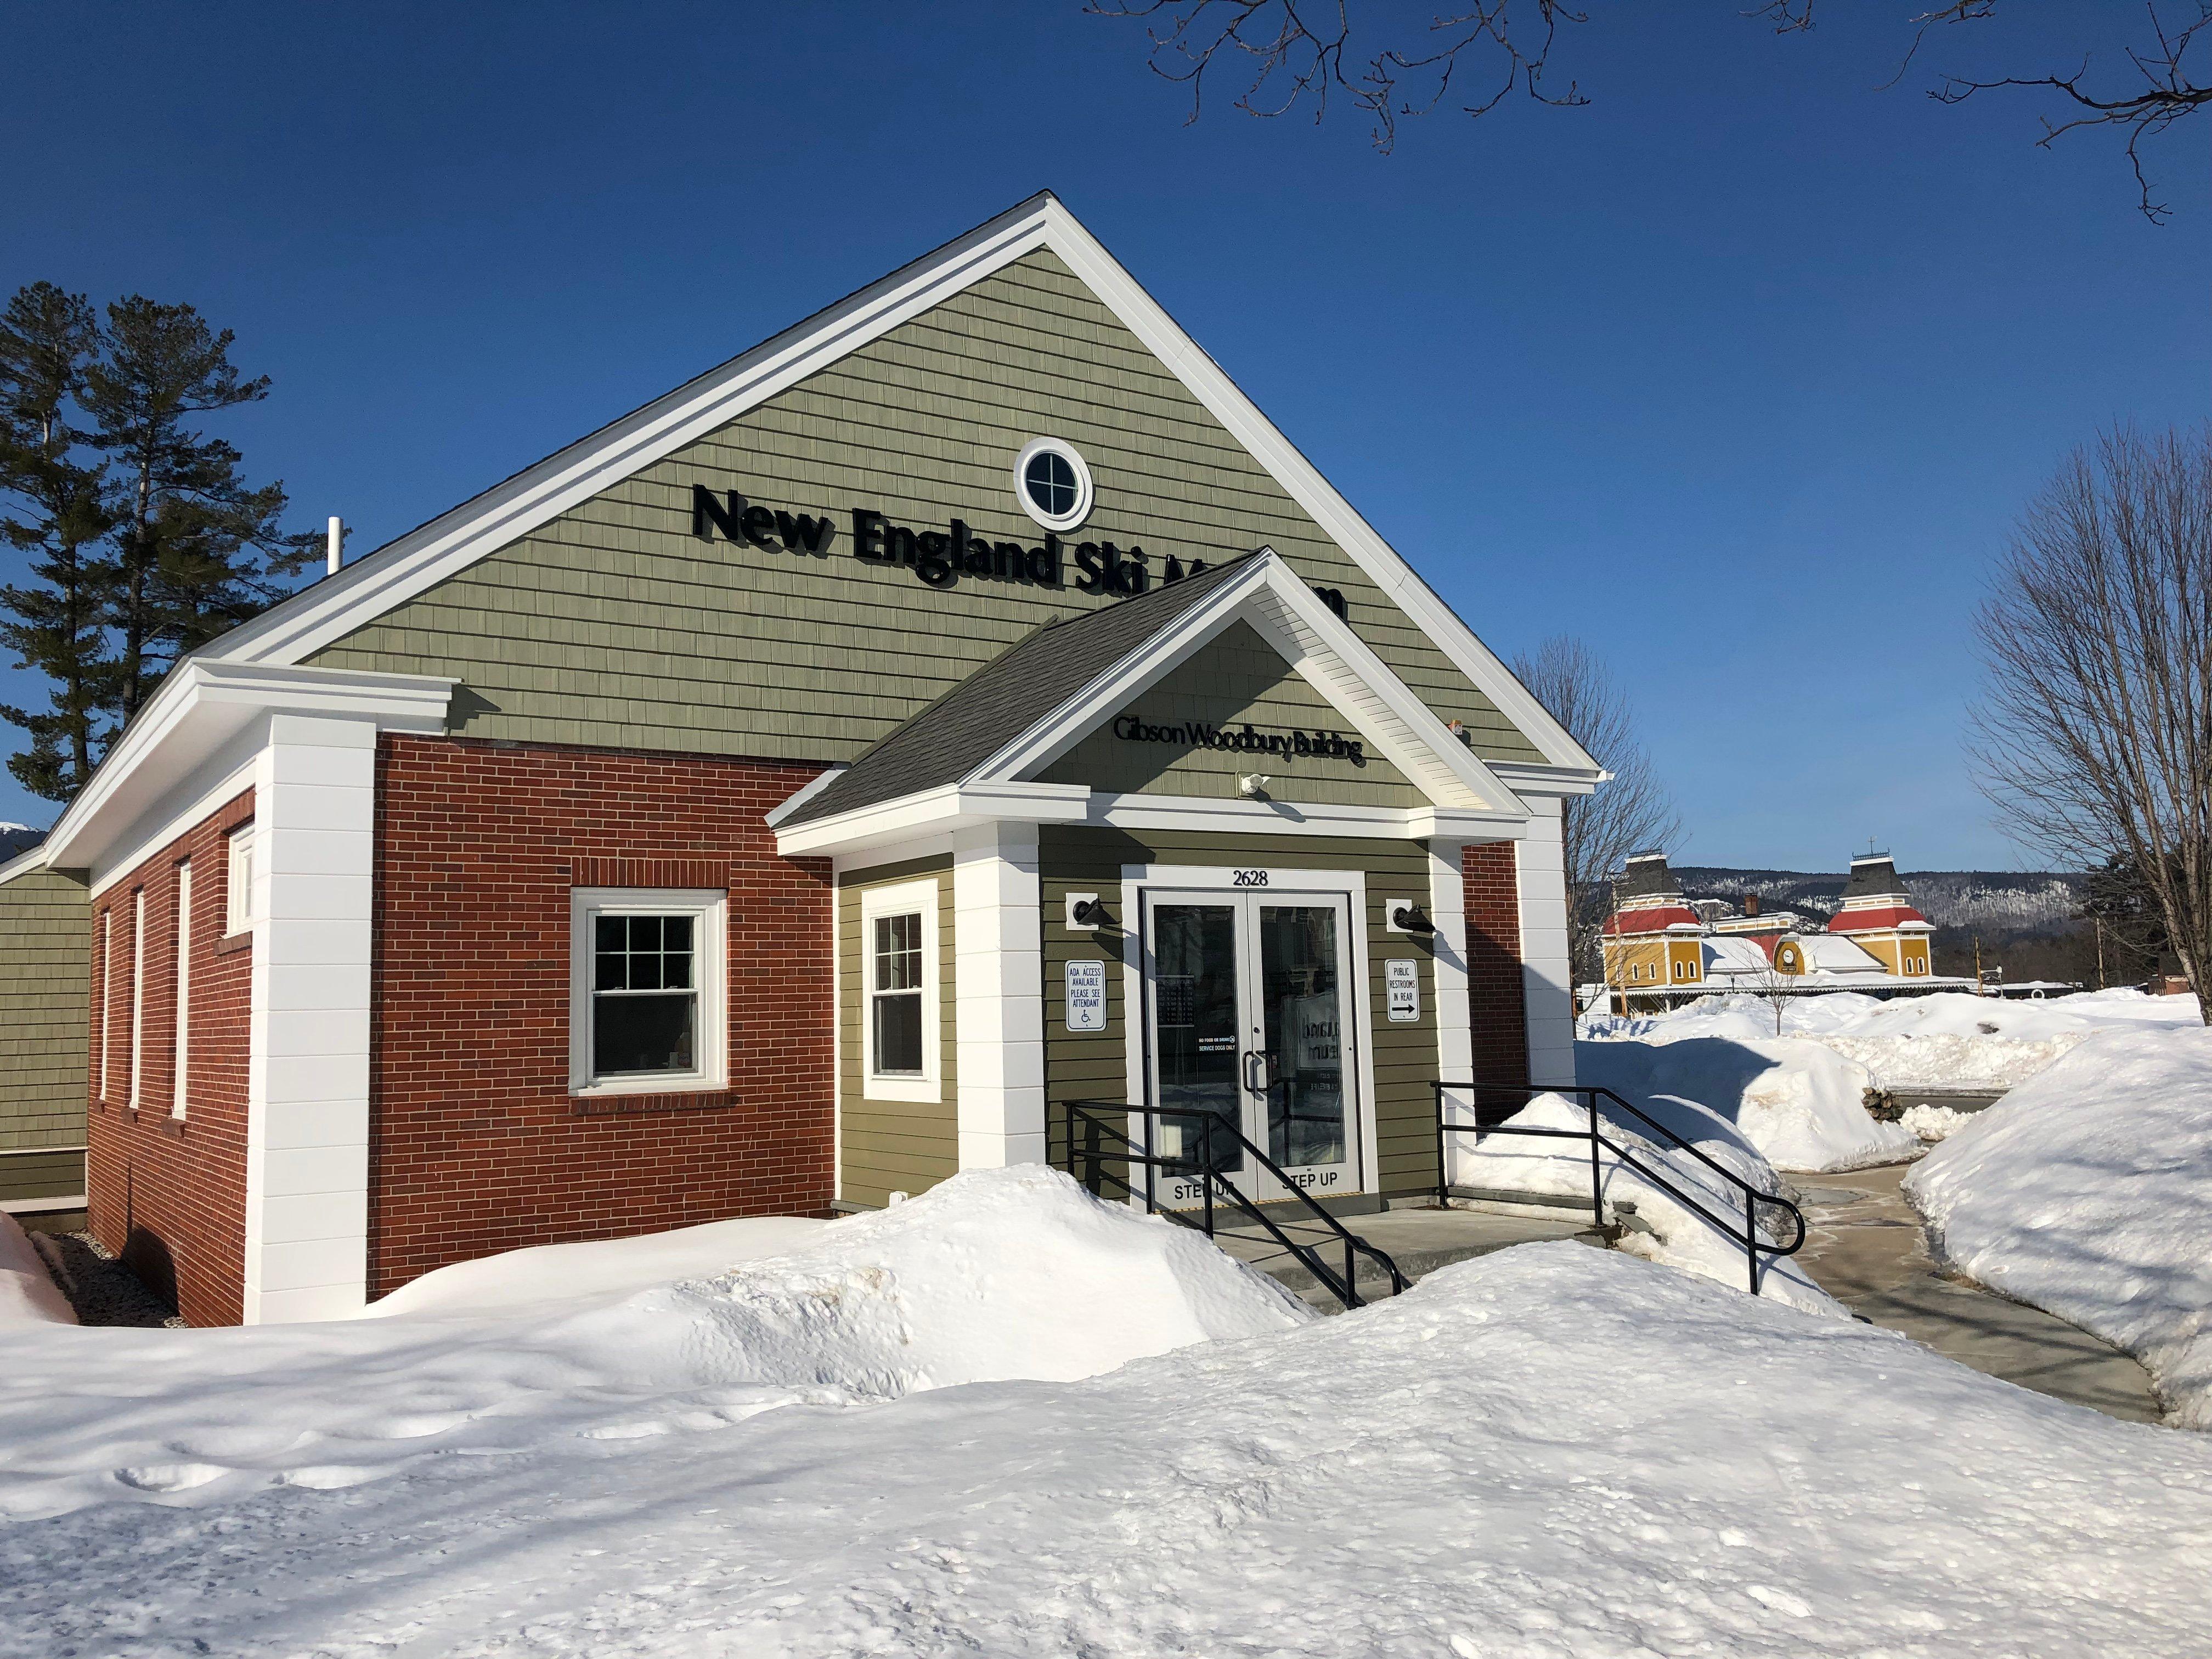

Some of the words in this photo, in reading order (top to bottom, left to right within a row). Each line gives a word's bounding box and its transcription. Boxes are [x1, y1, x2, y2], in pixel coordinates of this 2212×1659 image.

[692, 483, 829, 551] New
[851, 507, 1057, 584] England
[1074, 540, 1144, 595] Ski
[1113, 716, 1186, 744] Gibson
[1185, 722, 1293, 759] Woodbury
[1293, 731, 1363, 764] Building
[1233, 870, 1269, 887] 2628
[1069, 968, 1080, 977] ADA
[1082, 968, 1101, 977] ACCESS
[1393, 967, 1409, 976] PUBLIC
[1072, 978, 1098, 986] AVAILABLE
[1389, 980, 1415, 989] RESTROOMS
[1070, 989, 1088, 997] PLEASE
[1091, 989, 1101, 997] SEE
[1393, 992, 1398, 1001] IN
[1400, 992, 1413, 1001] REAR
[1073, 999, 1099, 1007] ATTENDANT
[1320, 1172, 1338, 1186] UP
[1174, 1184, 1206, 1200] STE
